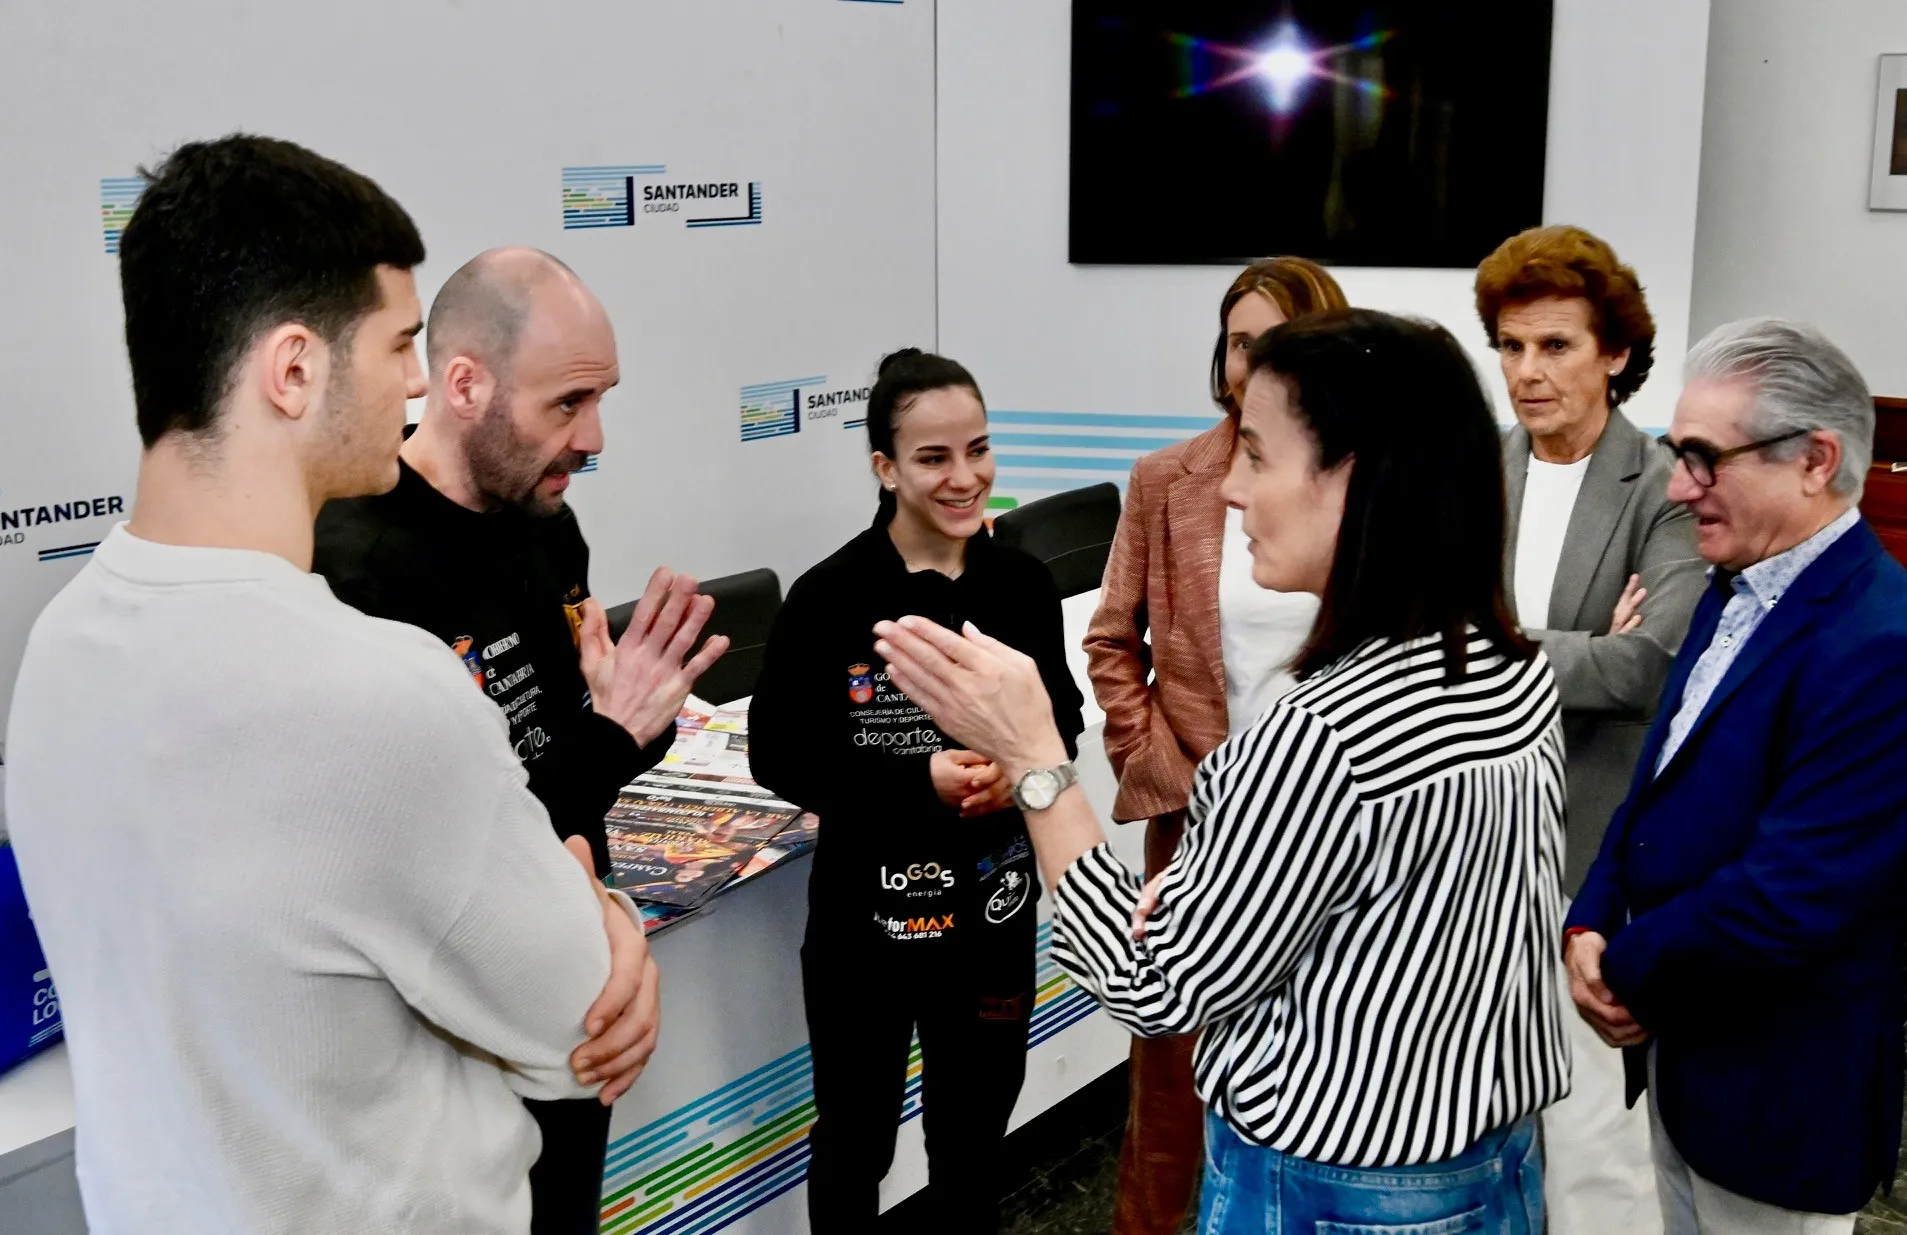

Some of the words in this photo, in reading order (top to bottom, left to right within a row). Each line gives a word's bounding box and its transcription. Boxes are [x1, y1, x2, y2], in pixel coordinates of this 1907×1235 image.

[643, 182, 739, 201] SANTANDER
[643, 203, 680, 213] CIUDAD
[808, 387, 871, 409] SANTAND
[0, 495, 124, 530] NTANDER
[876, 684, 886, 692] de
[898, 713, 934, 723] DEPORTE
[928, 930, 943, 938] 216
